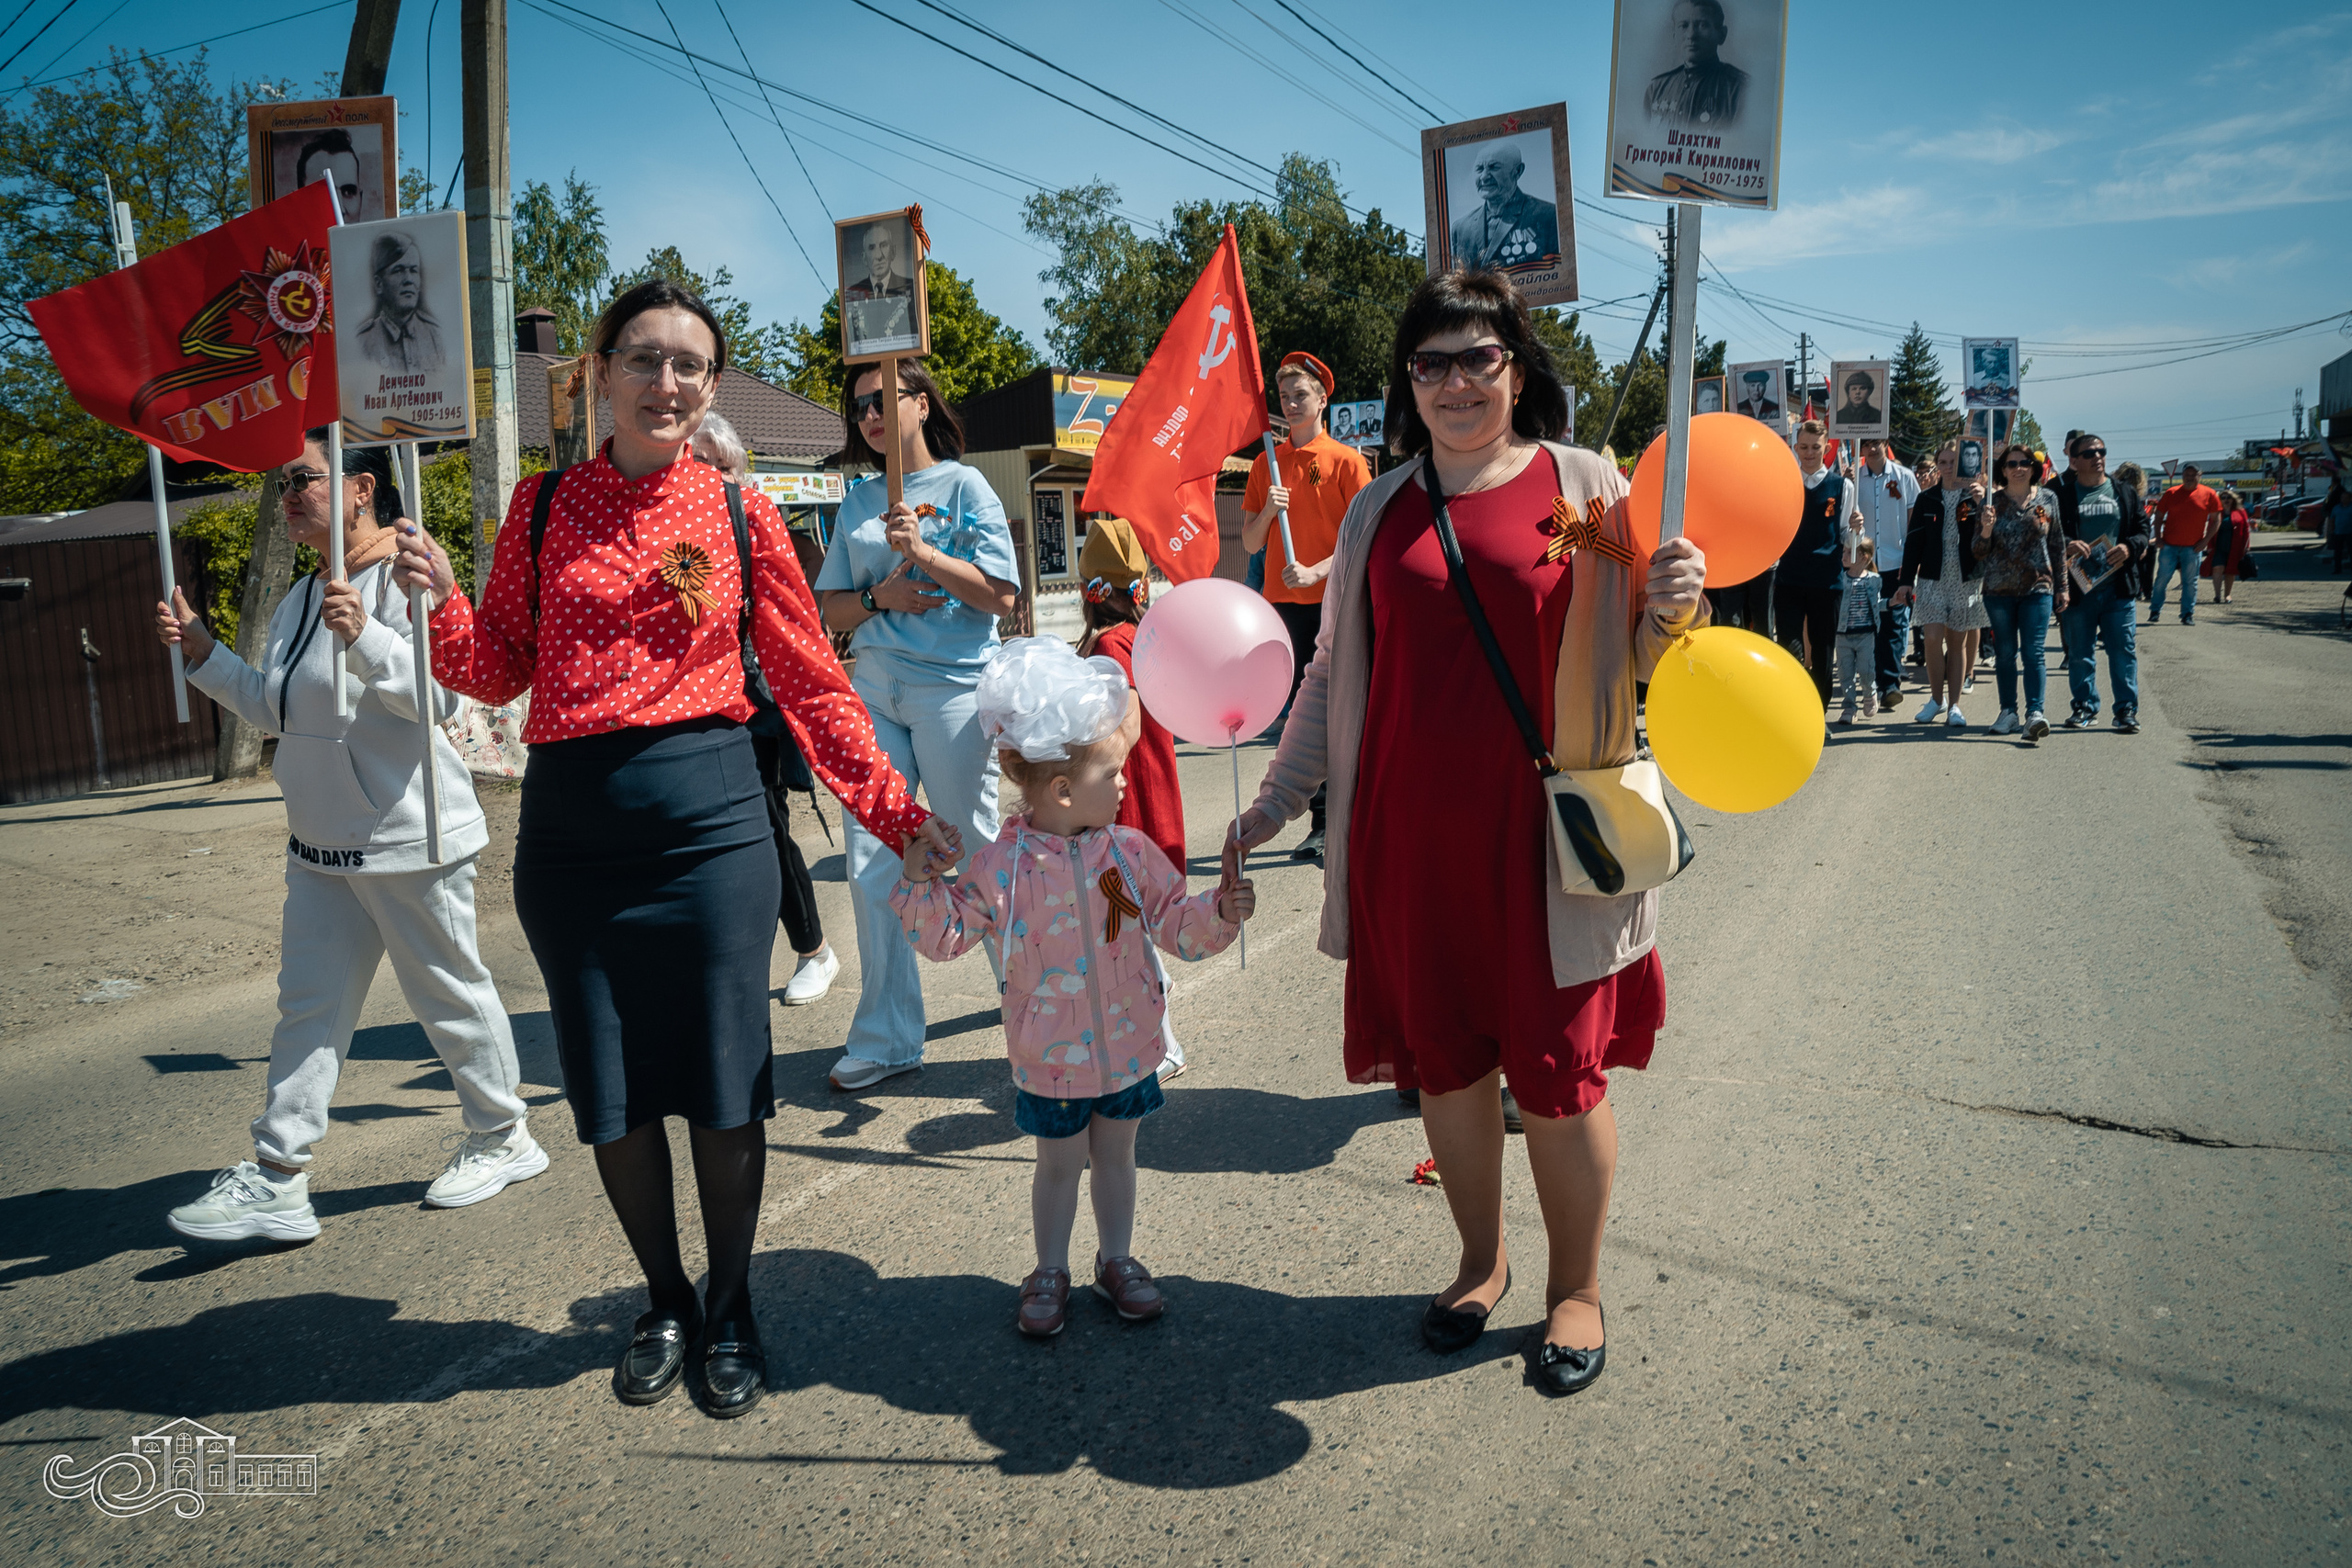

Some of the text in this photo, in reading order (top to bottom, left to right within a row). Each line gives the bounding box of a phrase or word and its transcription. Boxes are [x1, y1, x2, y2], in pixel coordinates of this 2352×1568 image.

[1668, 130, 1722, 150] Шляхтин
[1625, 144, 1760, 173] Григорий Кириллович
[1702, 171, 1765, 189] 1907-1975
[379, 373, 425, 394] Демченко
[162, 374, 282, 445] МАЯ
[364, 390, 443, 411] Иван Артёмович
[412, 406, 462, 423] 1905-1945
[2078, 503, 2113, 515] PUMA
[300, 842, 320, 863] BAD
[322, 850, 364, 867] DAYS
